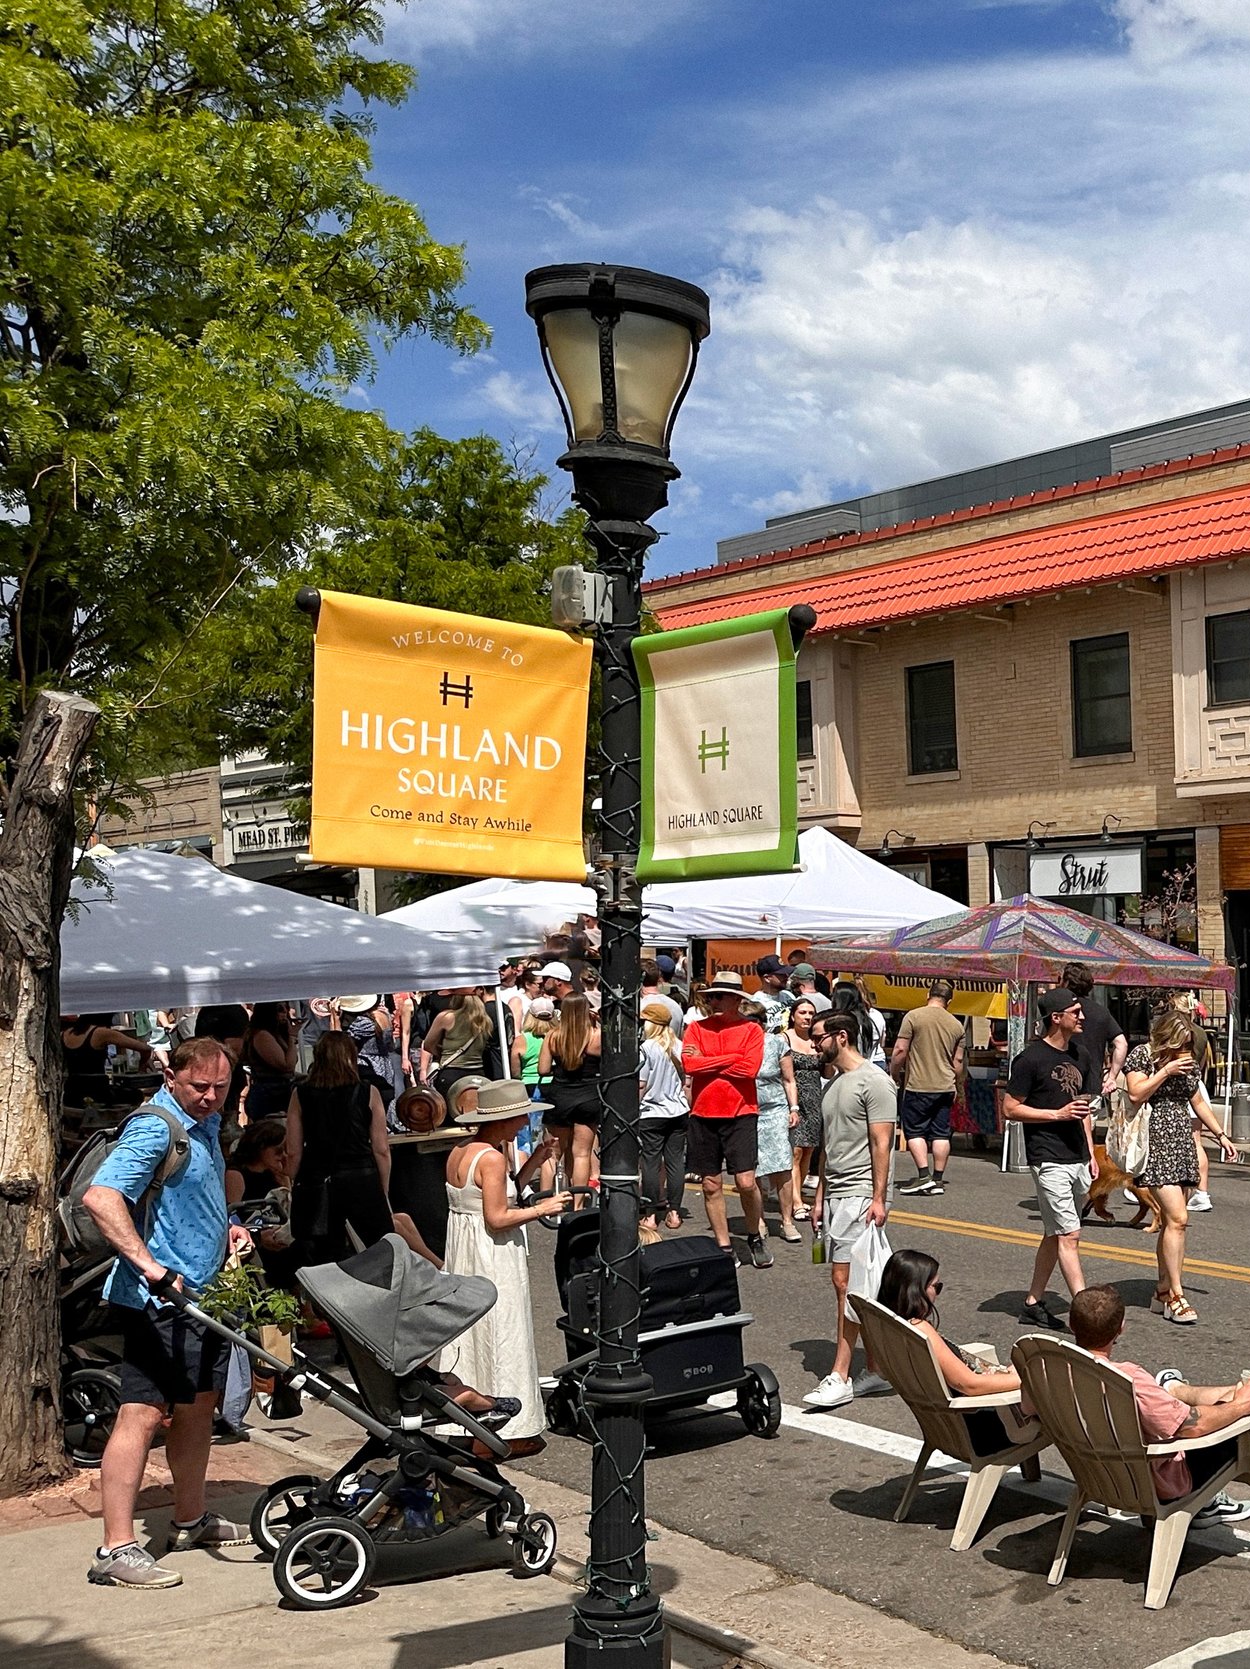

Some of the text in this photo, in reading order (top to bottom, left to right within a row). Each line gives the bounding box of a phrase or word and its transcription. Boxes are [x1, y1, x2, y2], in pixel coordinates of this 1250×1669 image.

[391, 630, 524, 666] WELCOME TO
[341, 710, 562, 771] HIGHLAND
[398, 767, 508, 803] SQUARE
[370, 804, 532, 832] Come and Stay Awhile
[668, 804, 763, 830] HIGHLAND SQUARE
[238, 829, 265, 847] MEAD
[268, 826, 281, 844] ST.
[1059, 853, 1109, 893] Strut
